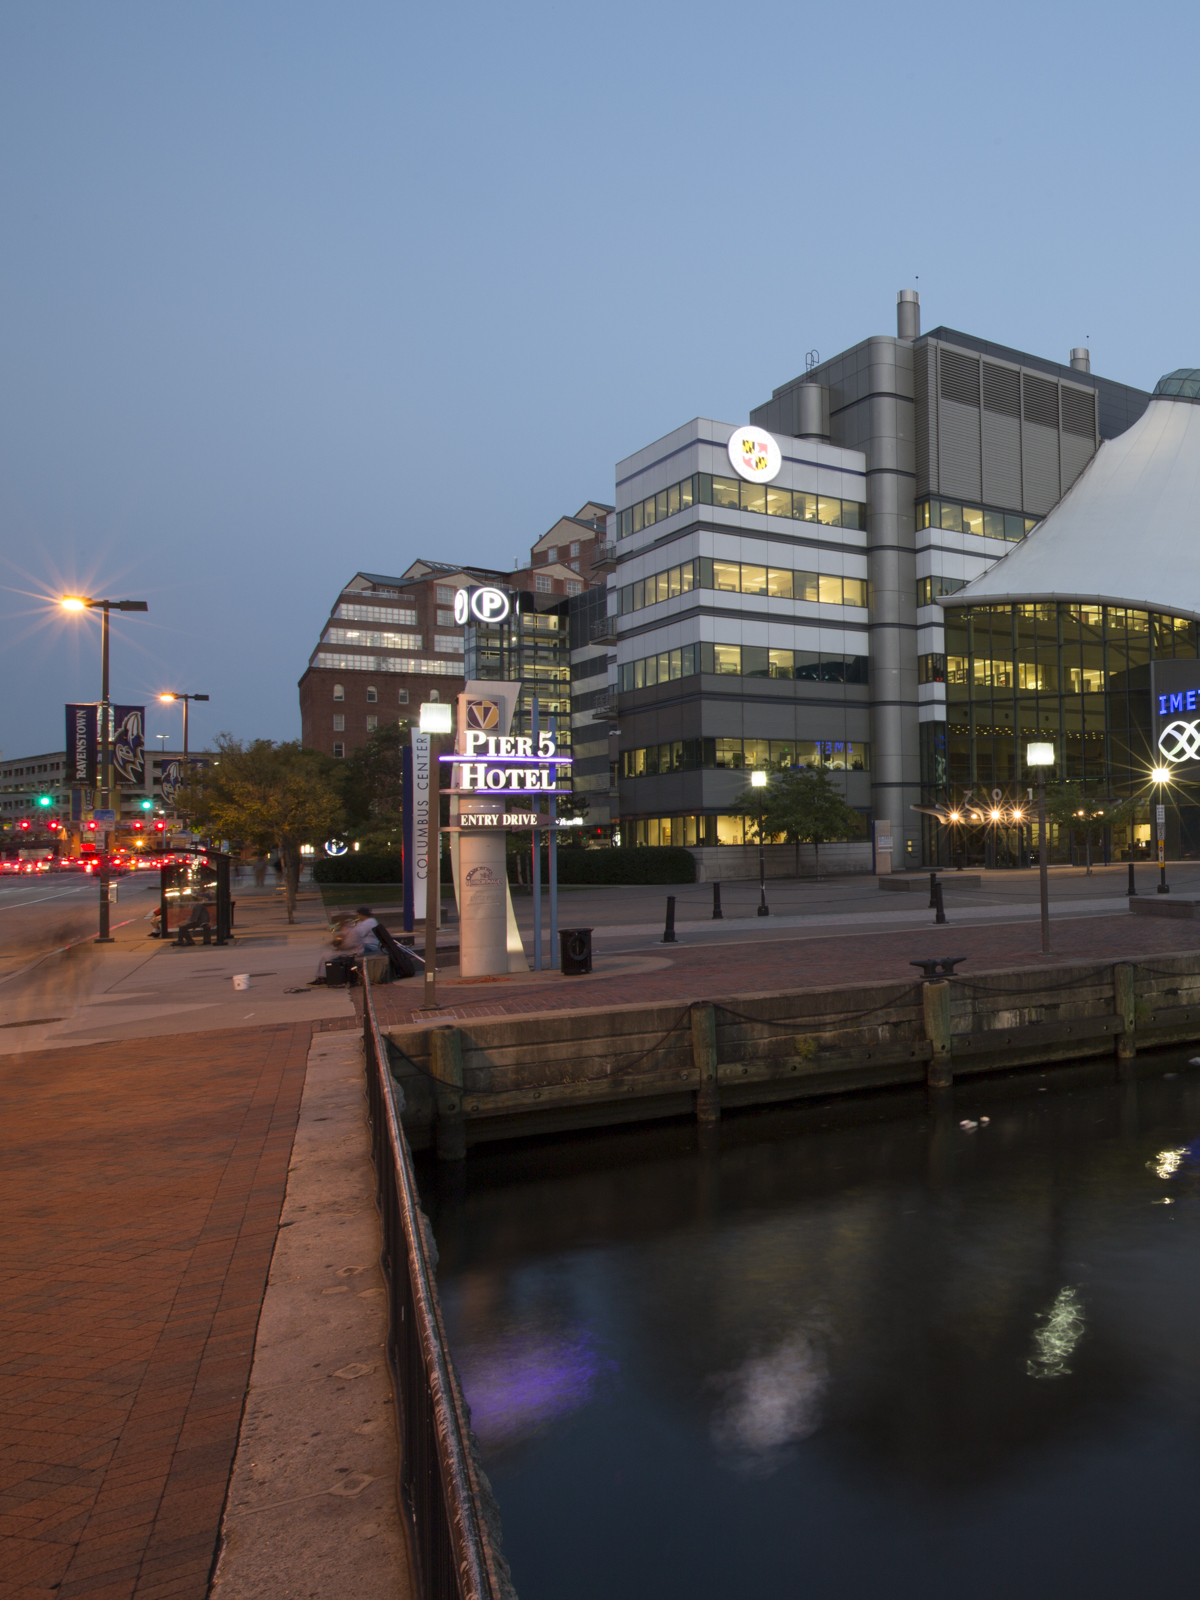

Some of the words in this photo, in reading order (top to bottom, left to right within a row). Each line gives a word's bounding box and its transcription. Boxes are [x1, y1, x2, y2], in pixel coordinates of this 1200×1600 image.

[76, 709, 87, 779] RAVENSTOWN
[463, 730, 534, 757] PIER
[537, 731, 556, 758] 5
[416, 737, 429, 791] CENTER
[459, 763, 556, 790] HOTEL
[963, 788, 1033, 803] 701
[460, 814, 499, 826] ENTRY
[502, 814, 538, 825] DRIVE
[416, 800, 429, 880] COLUMBUS
